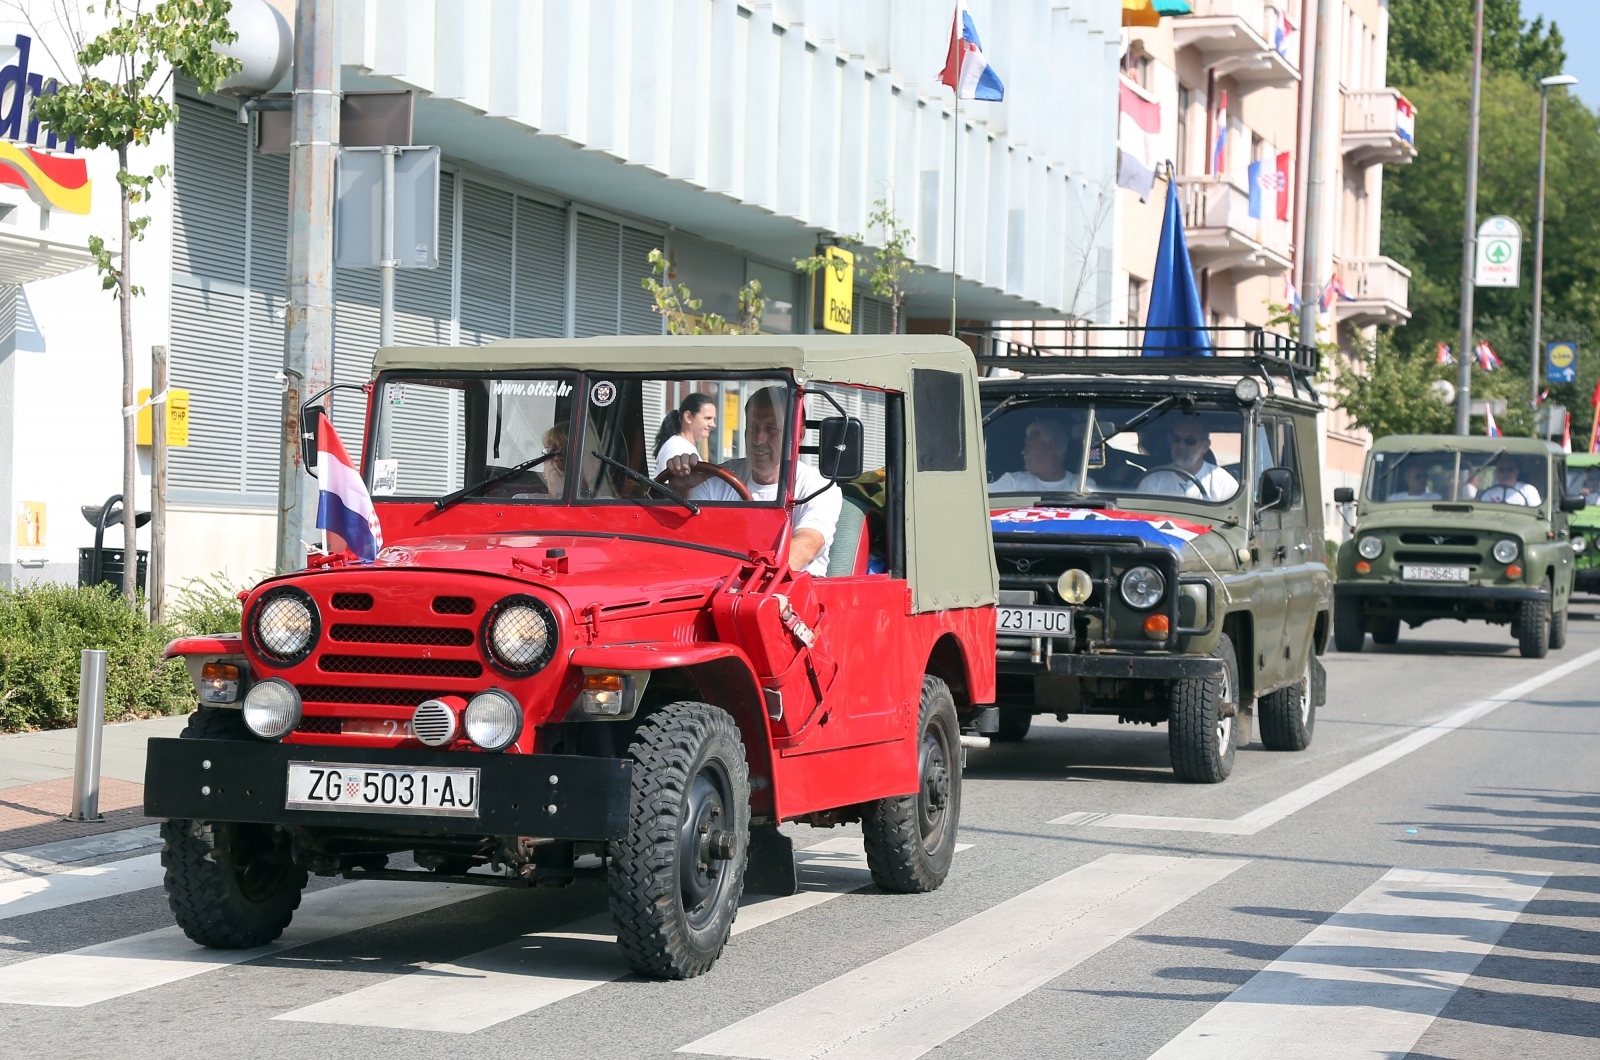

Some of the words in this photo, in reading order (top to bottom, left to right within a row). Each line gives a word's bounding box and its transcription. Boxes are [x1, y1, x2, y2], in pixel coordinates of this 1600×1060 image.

[492, 380, 573, 397] www.otks.hr
[177, 411, 186, 421] HP
[1001, 609, 1067, 631] 231-UC
[308, 769, 342, 801] ZG
[363, 772, 475, 808] 5031-AJ
